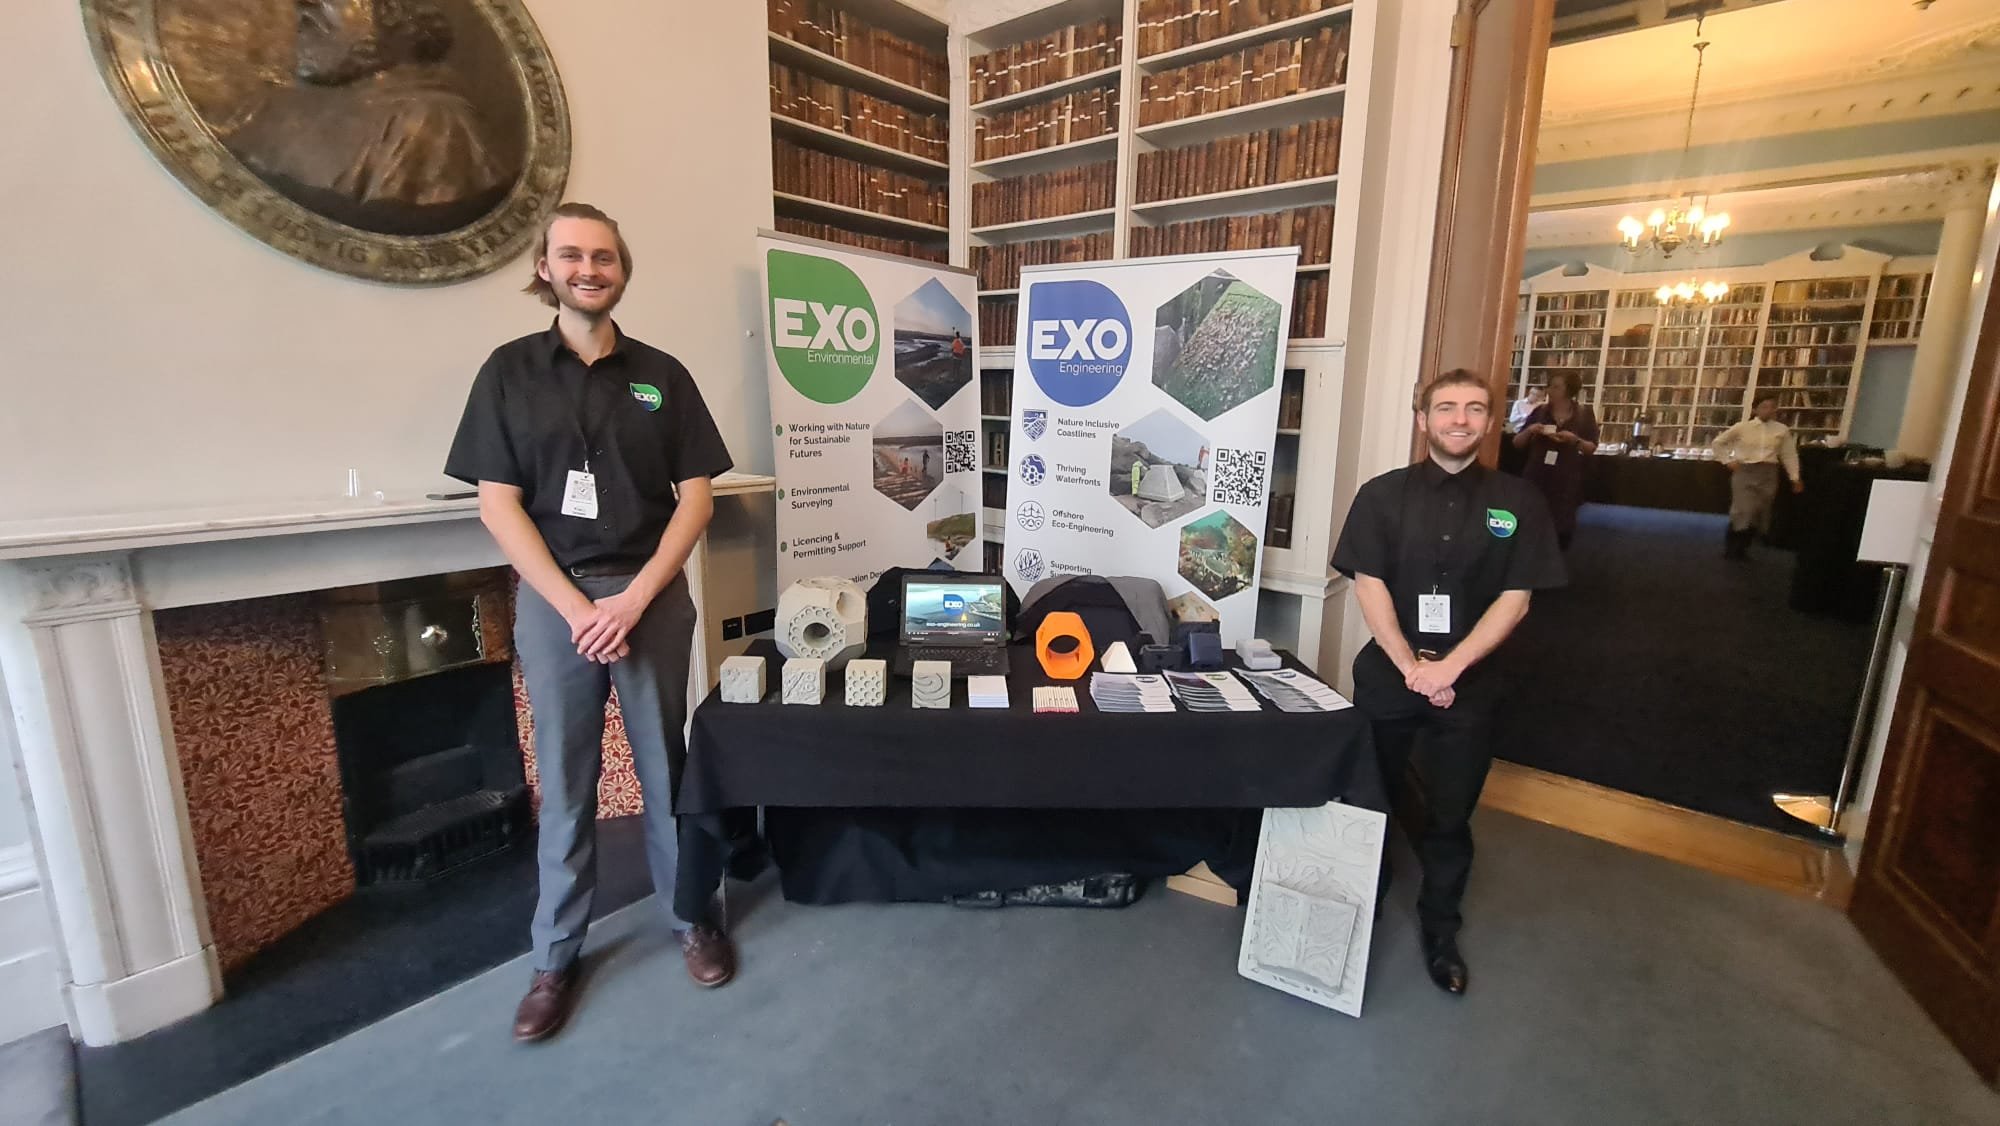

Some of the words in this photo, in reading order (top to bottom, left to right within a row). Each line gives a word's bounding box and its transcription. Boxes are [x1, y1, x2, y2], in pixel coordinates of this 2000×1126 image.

[774, 298, 875, 352] EXO
[1031, 318, 1127, 360] EXO
[807, 350, 874, 365] Environmental
[1059, 361, 1122, 376] Engineering
[634, 391, 657, 402] EXO
[788, 424, 824, 435] Working
[827, 423, 843, 431] with
[845, 422, 869, 430] Nature
[1057, 418, 1082, 427] Nature
[1085, 419, 1119, 429] Inclusive
[1057, 429, 1095, 438] Coastlines
[789, 436, 800, 445] for
[803, 435, 850, 444] Sustainable
[789, 449, 822, 458] Futures
[1056, 463, 1086, 474] Thriving
[1055, 474, 1100, 486] Waterfronts
[791, 483, 849, 496] Environmental
[791, 498, 832, 509] Surveying
[1052, 509, 1084, 520] Offshore
[1051, 520, 1114, 536] Eco-Engineering
[1489, 518, 1512, 528] EXO
[793, 534, 832, 546] Licencing
[834, 532, 839, 540] &
[793, 546, 836, 558] Permitting
[837, 539, 866, 552] Support
[1050, 560, 1091, 575] Supporting
